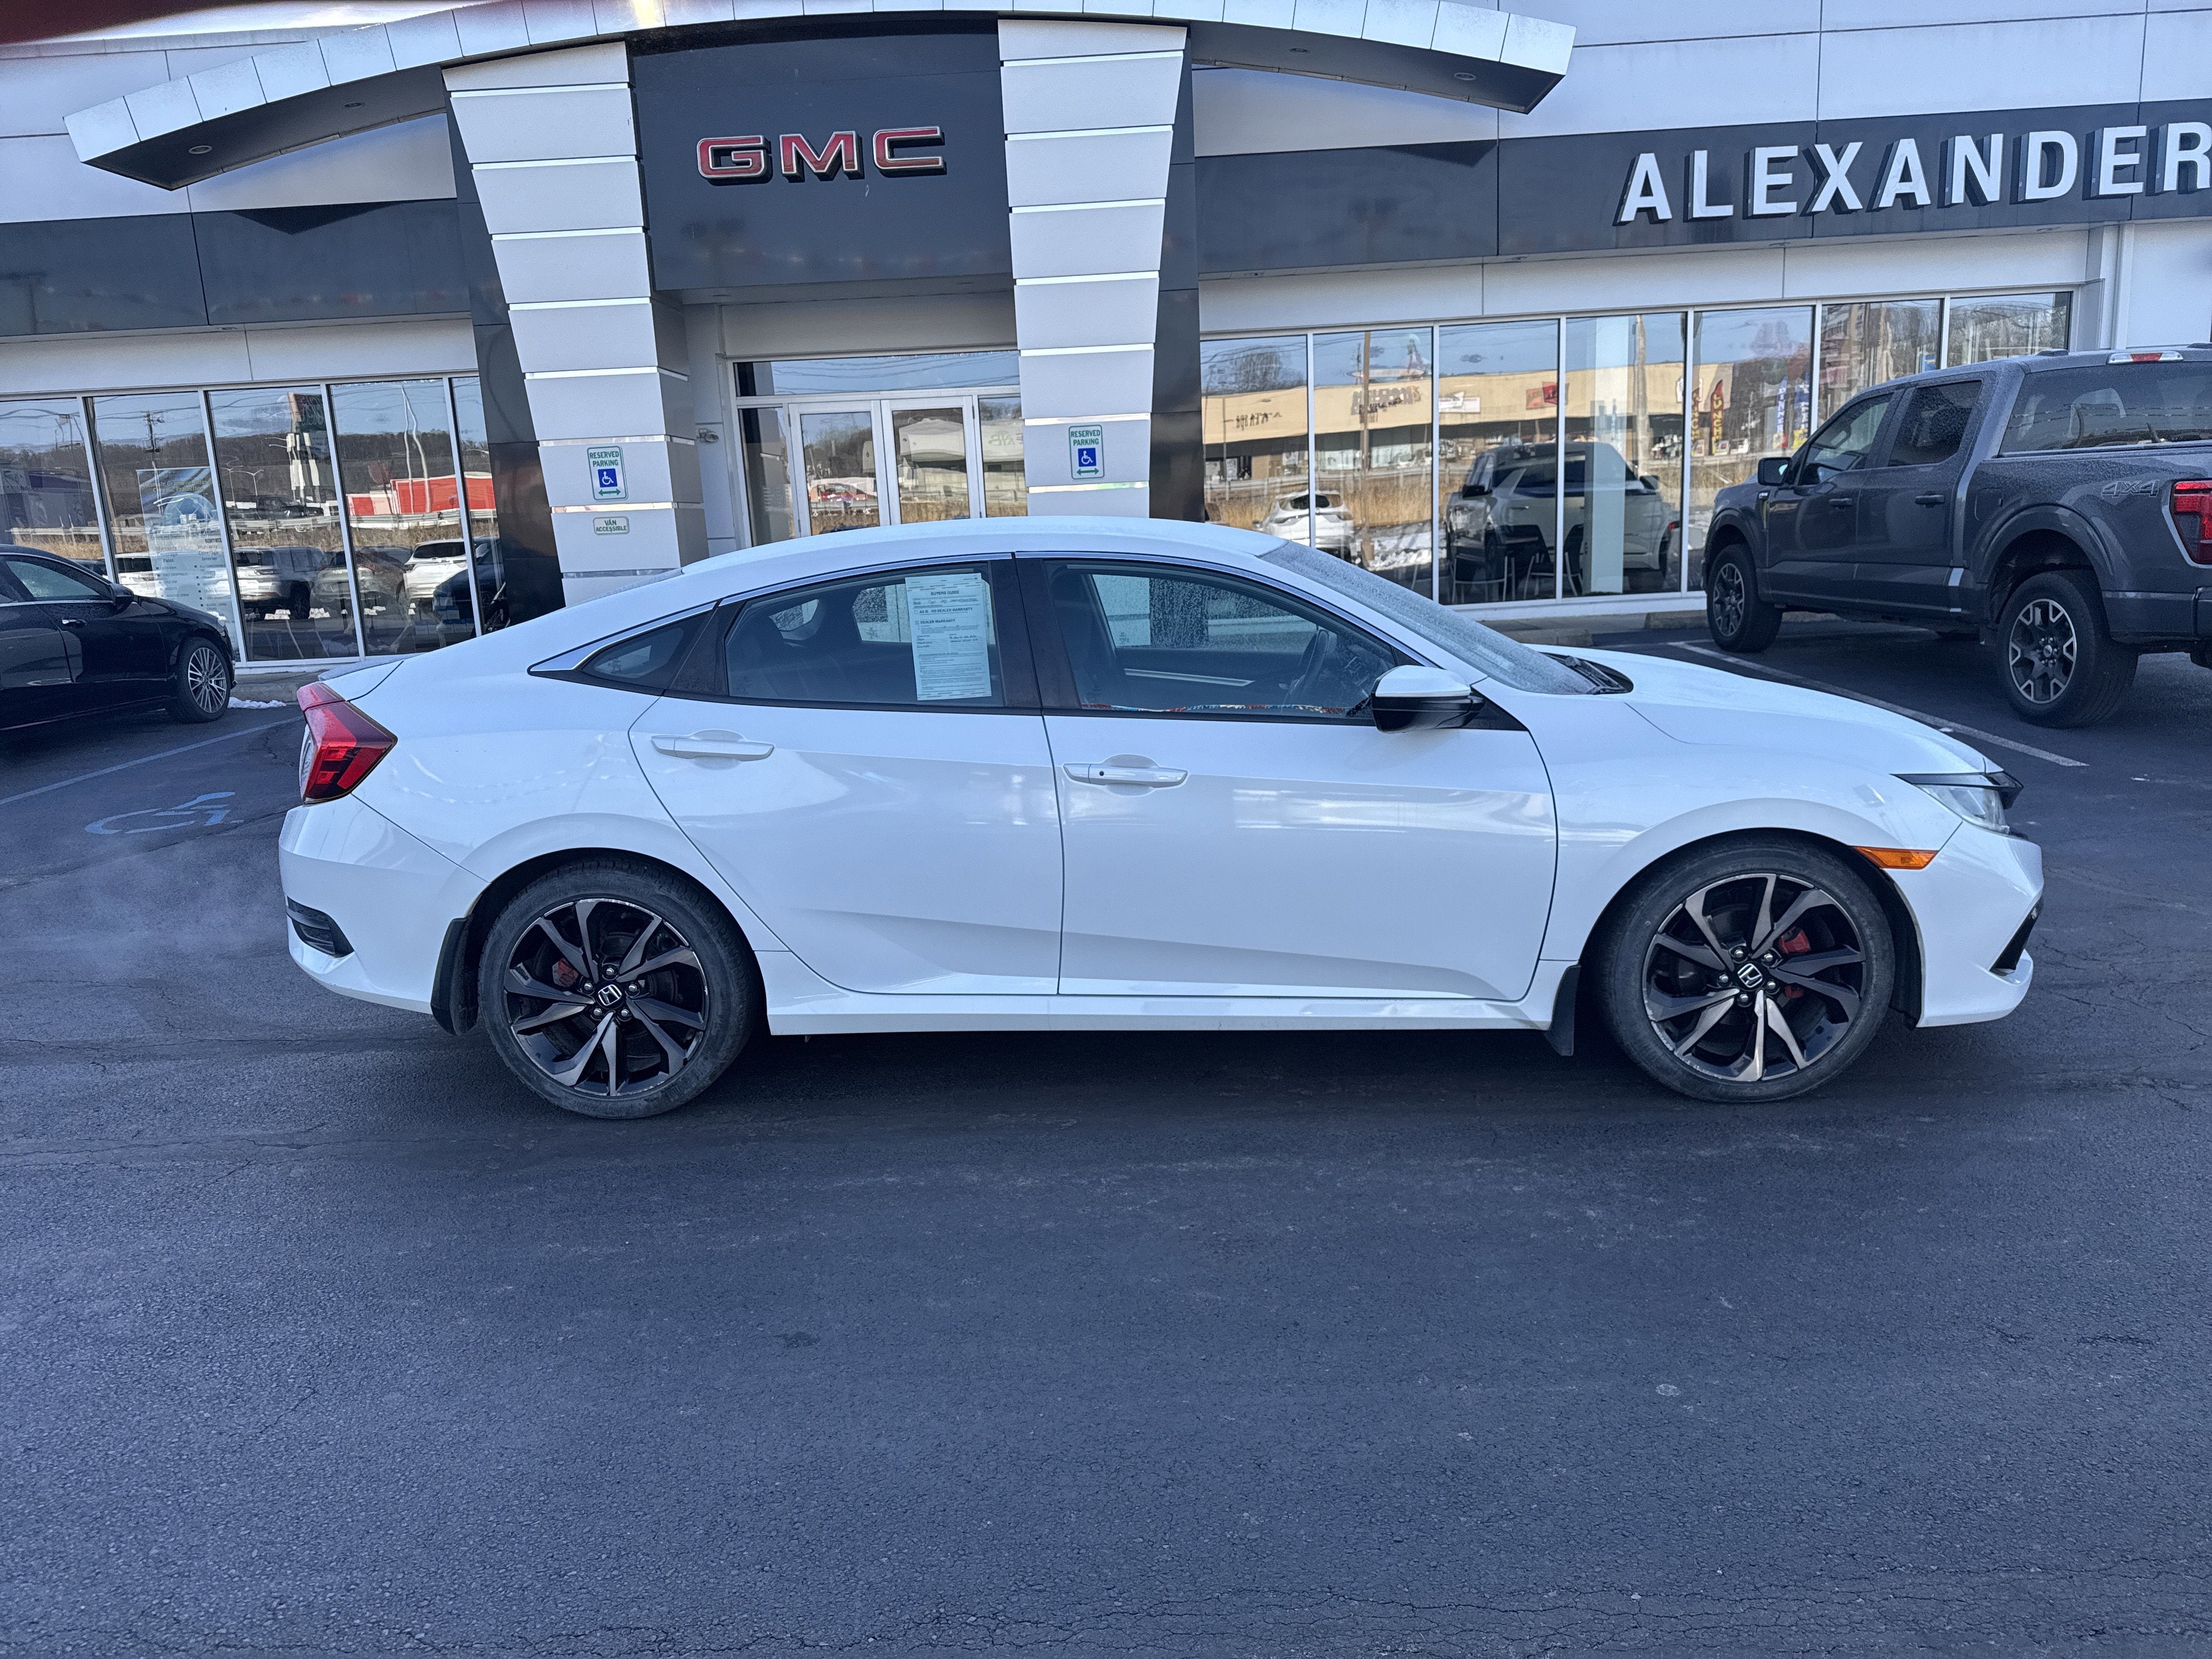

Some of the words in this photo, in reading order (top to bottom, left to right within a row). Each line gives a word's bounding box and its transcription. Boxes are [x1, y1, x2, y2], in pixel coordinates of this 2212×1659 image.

[696, 126, 944, 179] GMC
[1620, 121, 2212, 222] ALEXANDER
[589, 451, 619, 459] RESERVED
